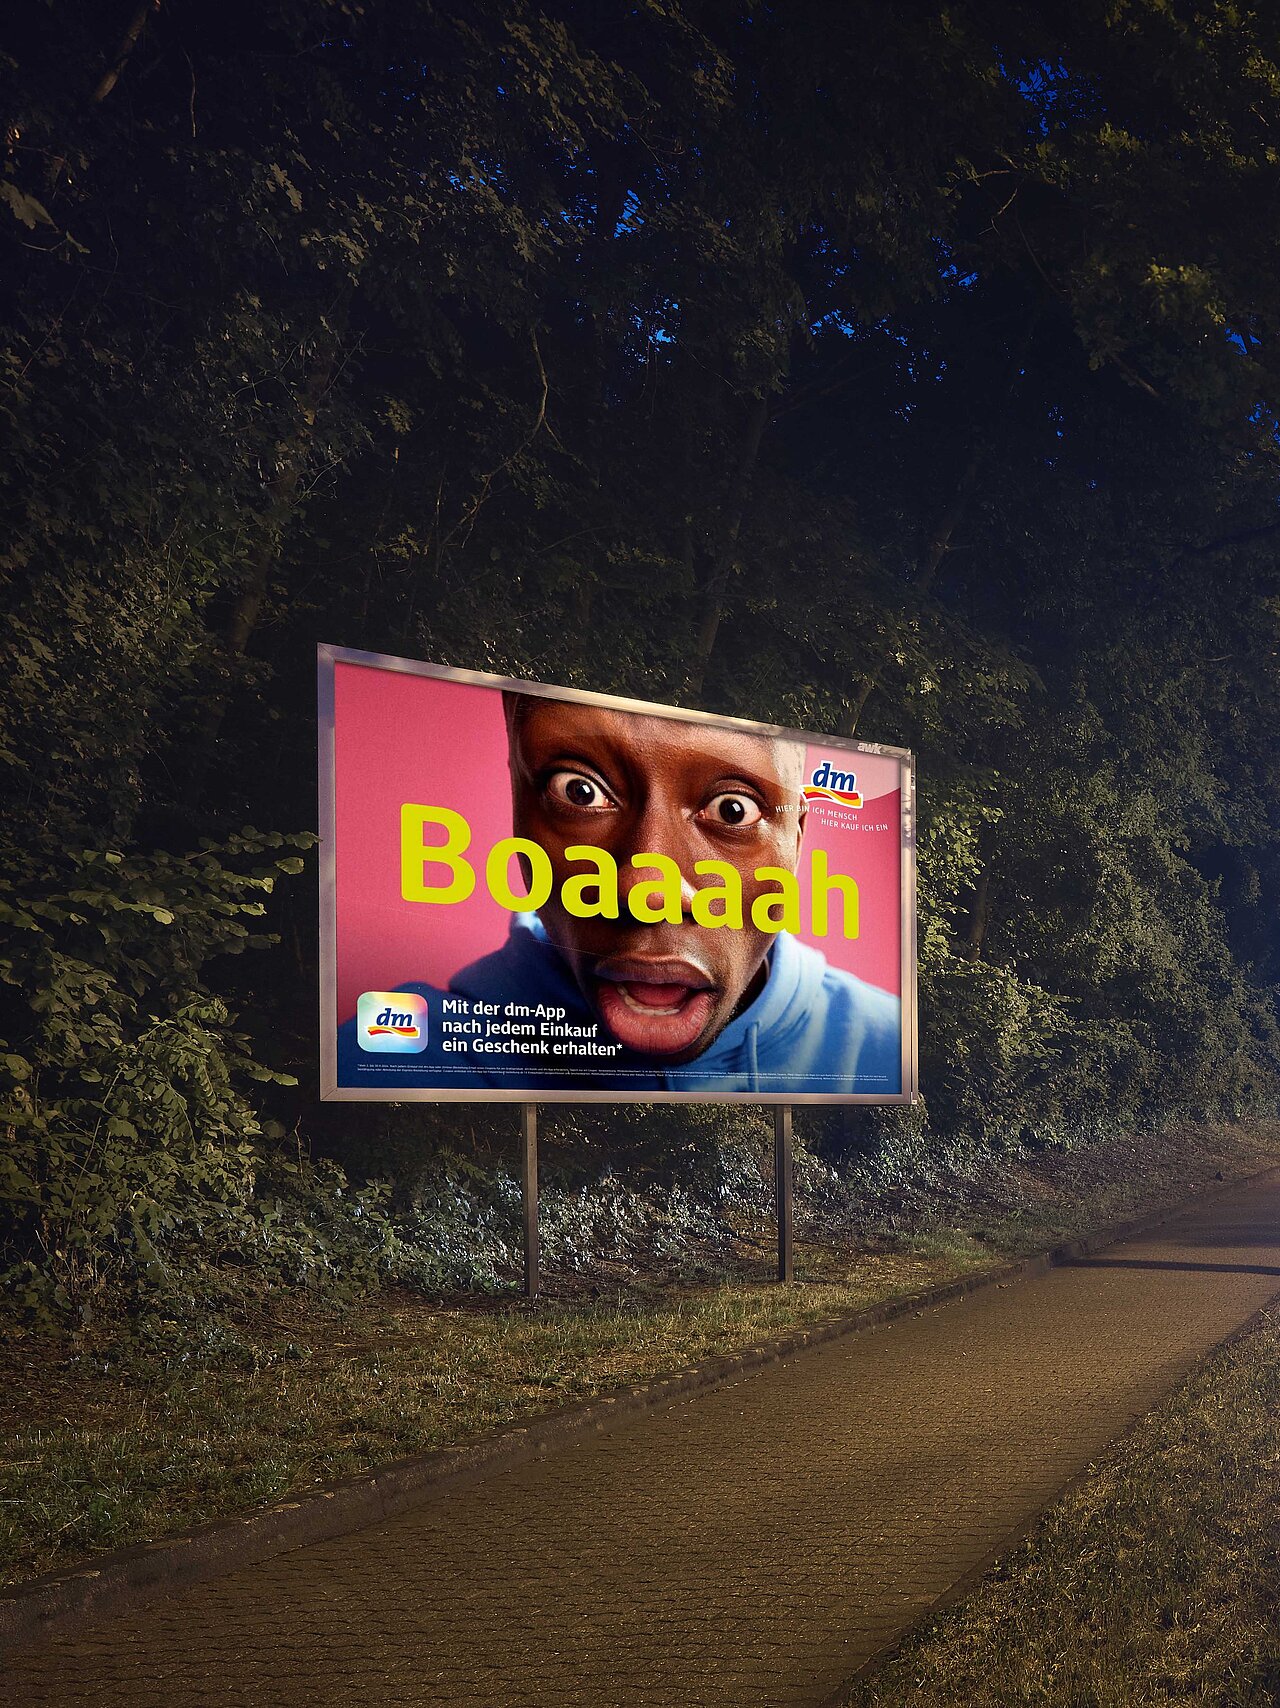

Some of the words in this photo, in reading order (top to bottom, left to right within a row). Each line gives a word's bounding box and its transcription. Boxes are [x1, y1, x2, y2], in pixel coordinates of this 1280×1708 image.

[857, 742, 881, 754] awk
[813, 762, 855, 792] dm
[775, 805, 794, 813] HIER
[797, 805, 810, 813] BIN
[812, 807, 825, 815] ICH
[827, 810, 858, 821] MENSCH
[821, 818, 839, 828] HIER
[841, 823, 860, 831] KAUF
[876, 823, 889, 831] EIN
[400, 803, 860, 940] Boaaaah
[376, 1007, 413, 1027] dm
[442, 999, 470, 1015] Mit
[473, 1000, 501, 1016] der
[504, 1001, 566, 1021] dm-App
[442, 1019, 482, 1034] nach
[485, 1019, 536, 1038] jedem
[540, 1021, 598, 1038] Einkauf
[442, 1037, 468, 1052] ein
[472, 1038, 550, 1055] Geschenk
